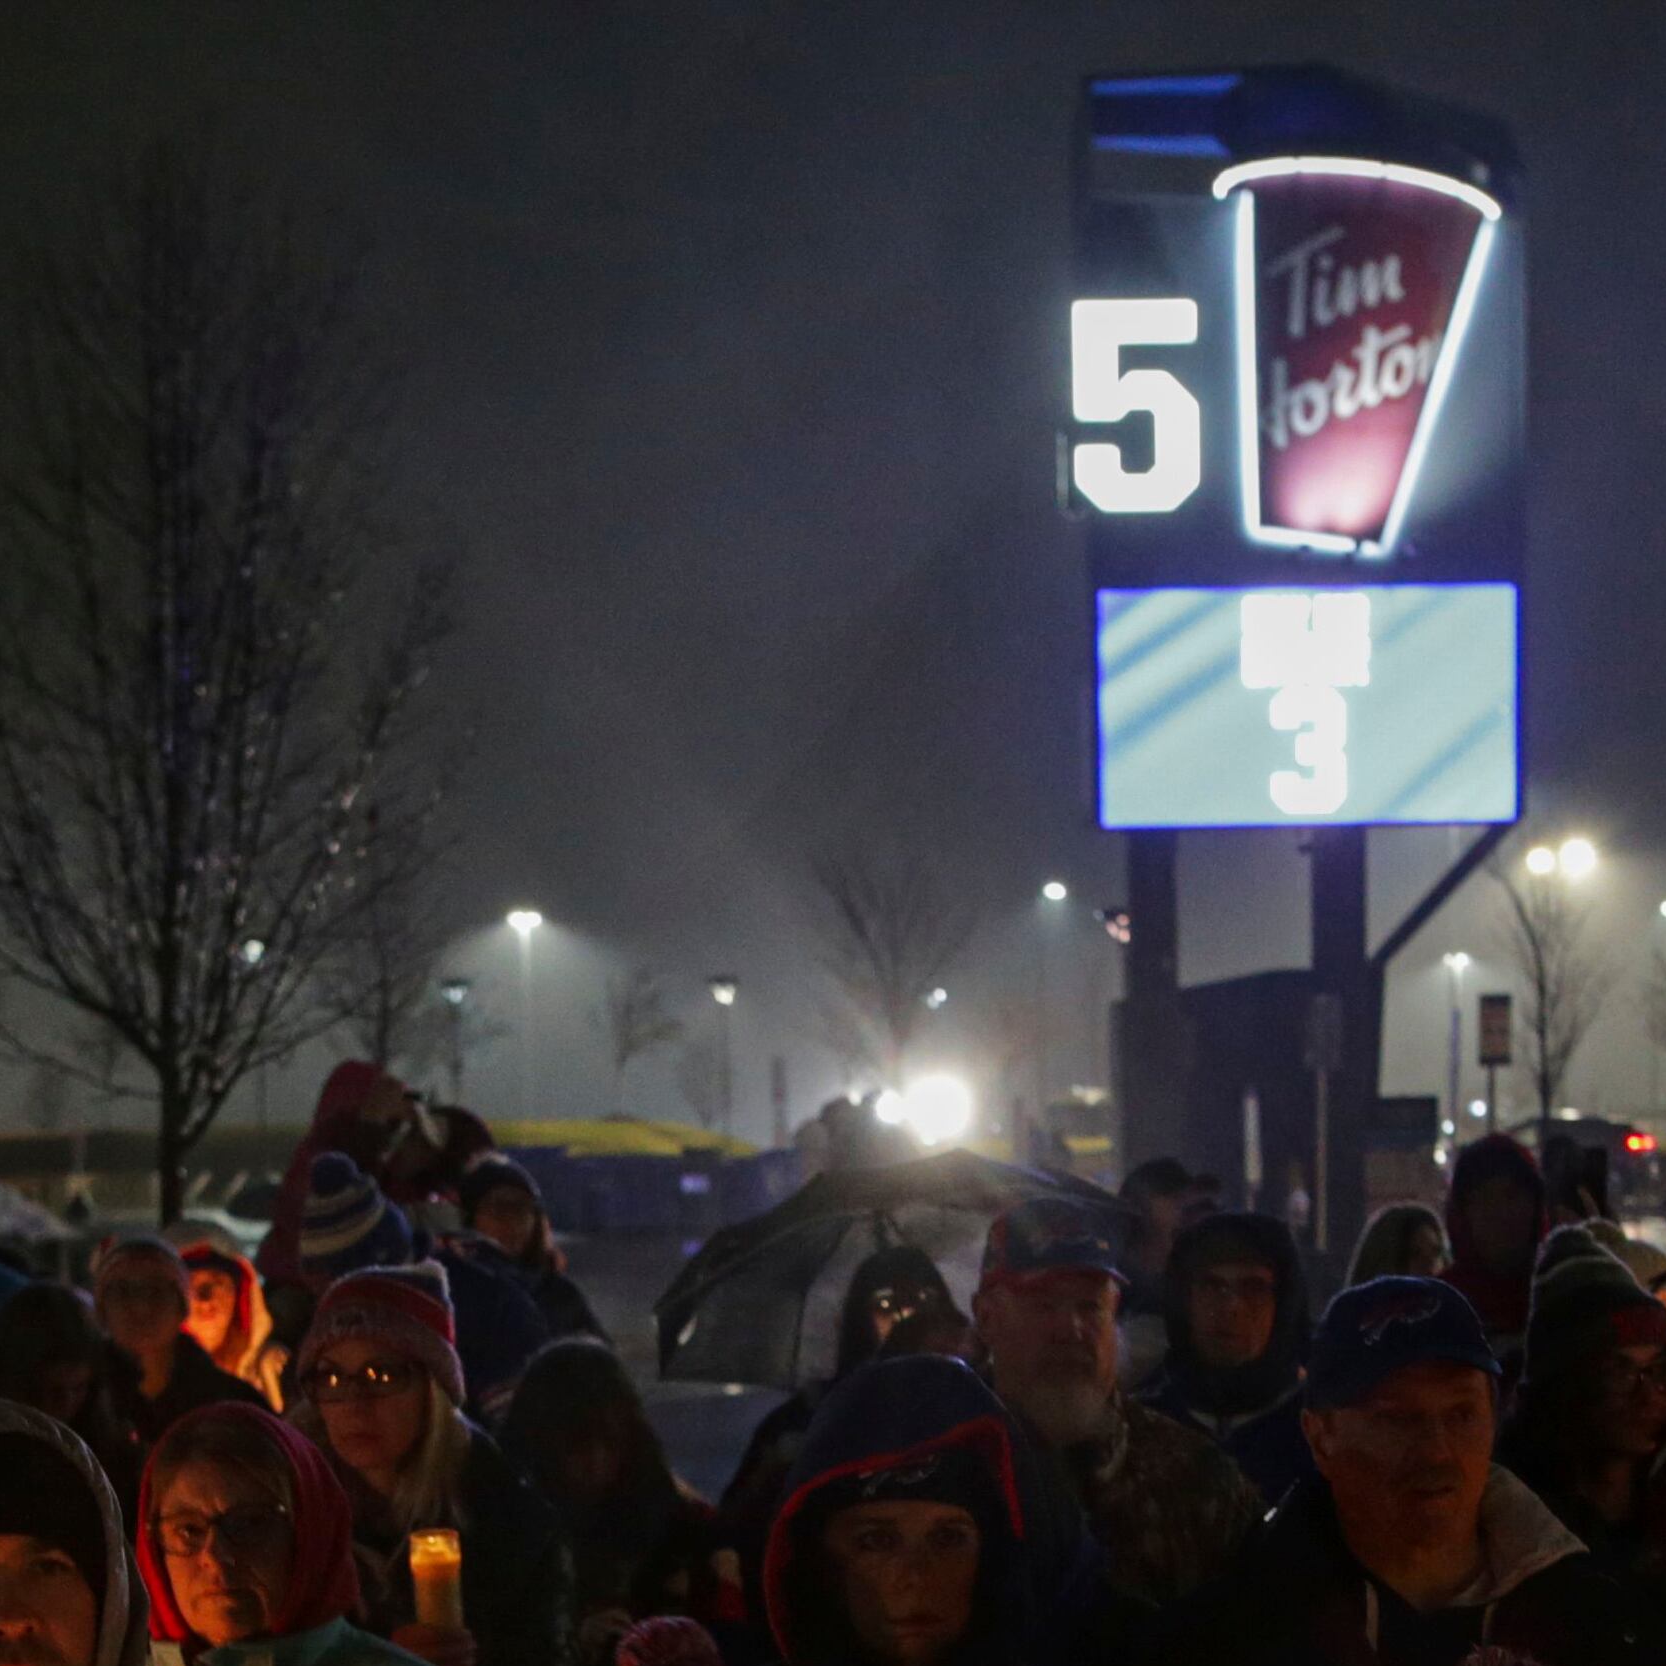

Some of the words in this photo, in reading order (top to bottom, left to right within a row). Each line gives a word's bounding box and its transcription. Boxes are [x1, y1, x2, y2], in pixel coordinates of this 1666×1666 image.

[1263, 224, 1406, 339] Tim
[1069, 297, 1201, 514] 5
[1268, 686, 1348, 816] 3
